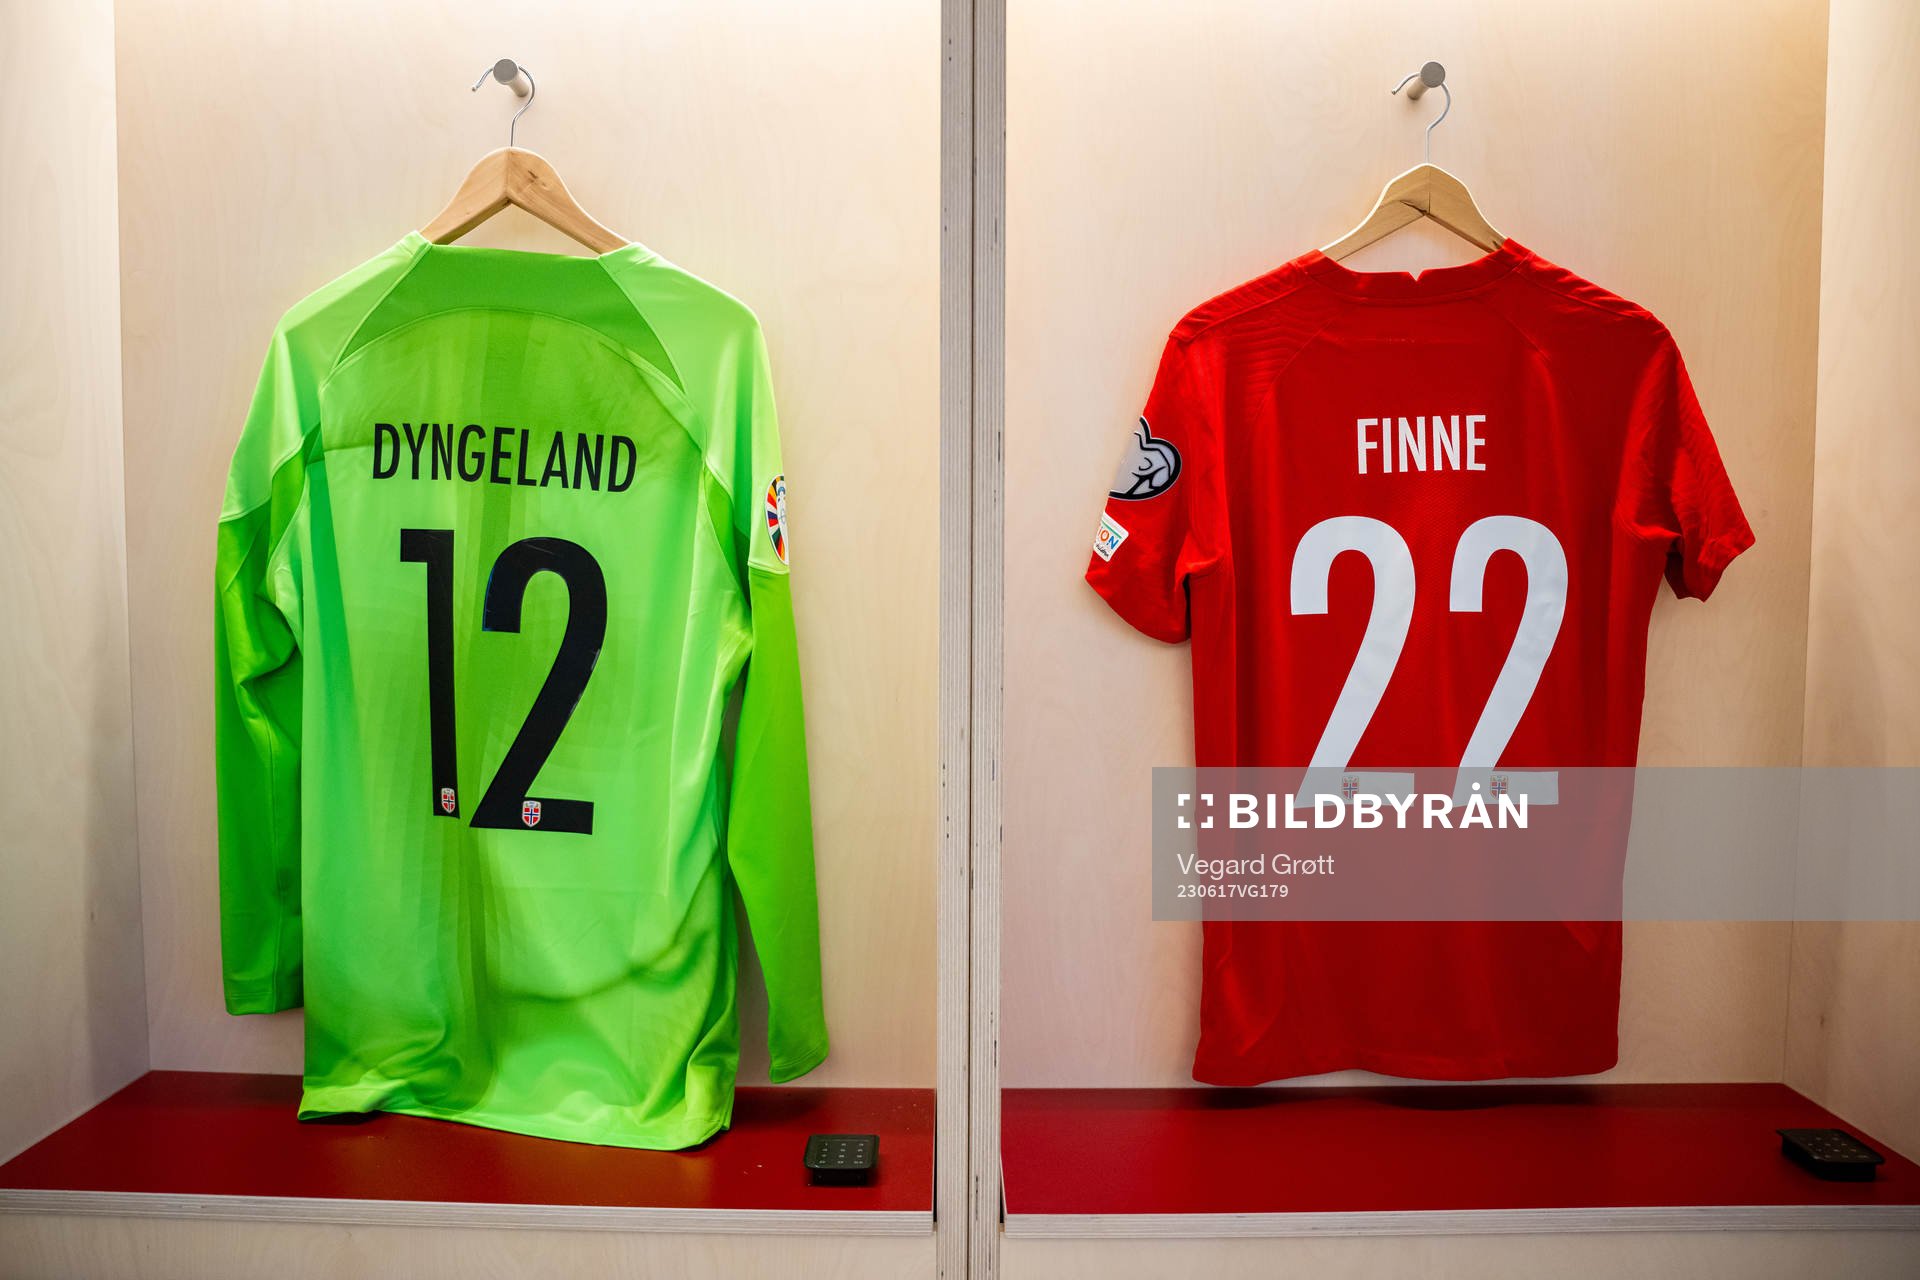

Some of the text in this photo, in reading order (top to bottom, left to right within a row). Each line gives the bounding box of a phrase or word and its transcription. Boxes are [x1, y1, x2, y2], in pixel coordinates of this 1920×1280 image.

[372, 423, 638, 492] DYNGELAND
[1356, 415, 1486, 474] FINNE
[401, 529, 608, 835] 12
[1290, 515, 1568, 808] 22
